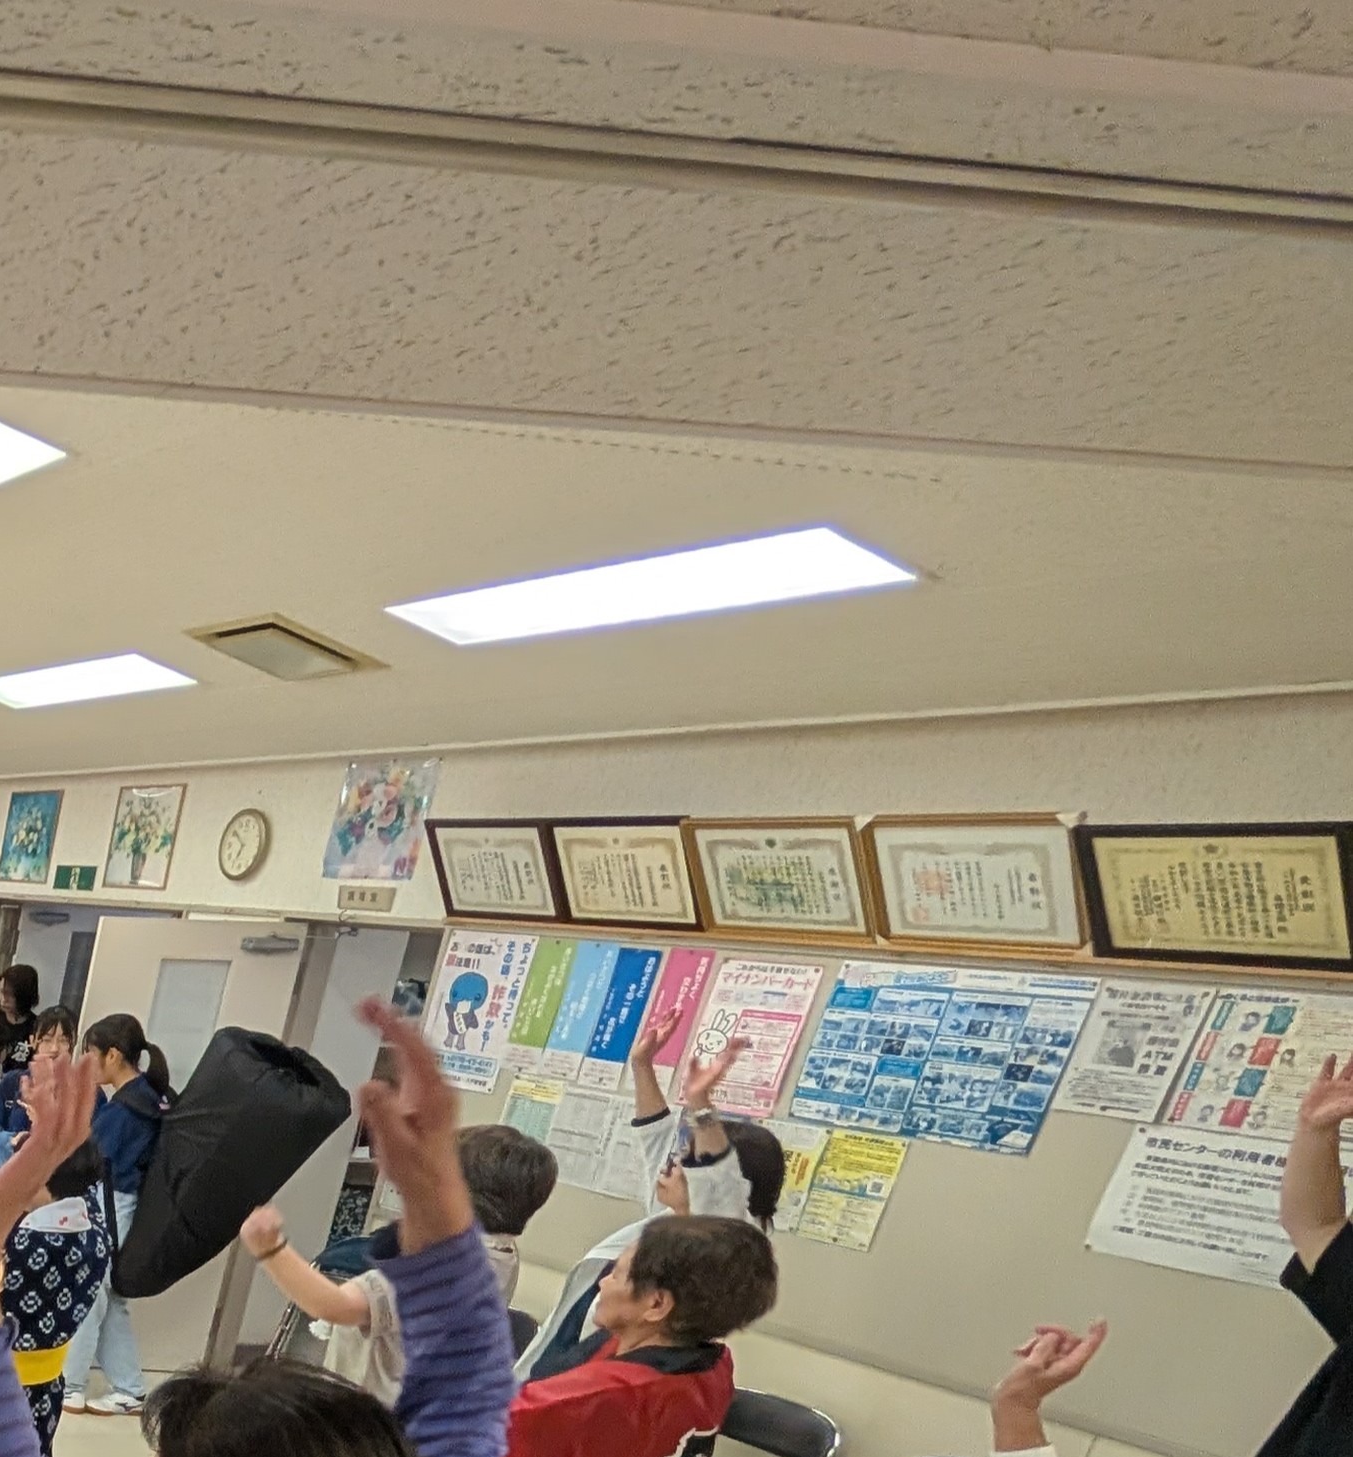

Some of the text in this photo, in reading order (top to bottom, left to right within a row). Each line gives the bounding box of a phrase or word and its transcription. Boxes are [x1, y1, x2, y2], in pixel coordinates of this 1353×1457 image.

[721, 971, 815, 991] マイナンバーカード
